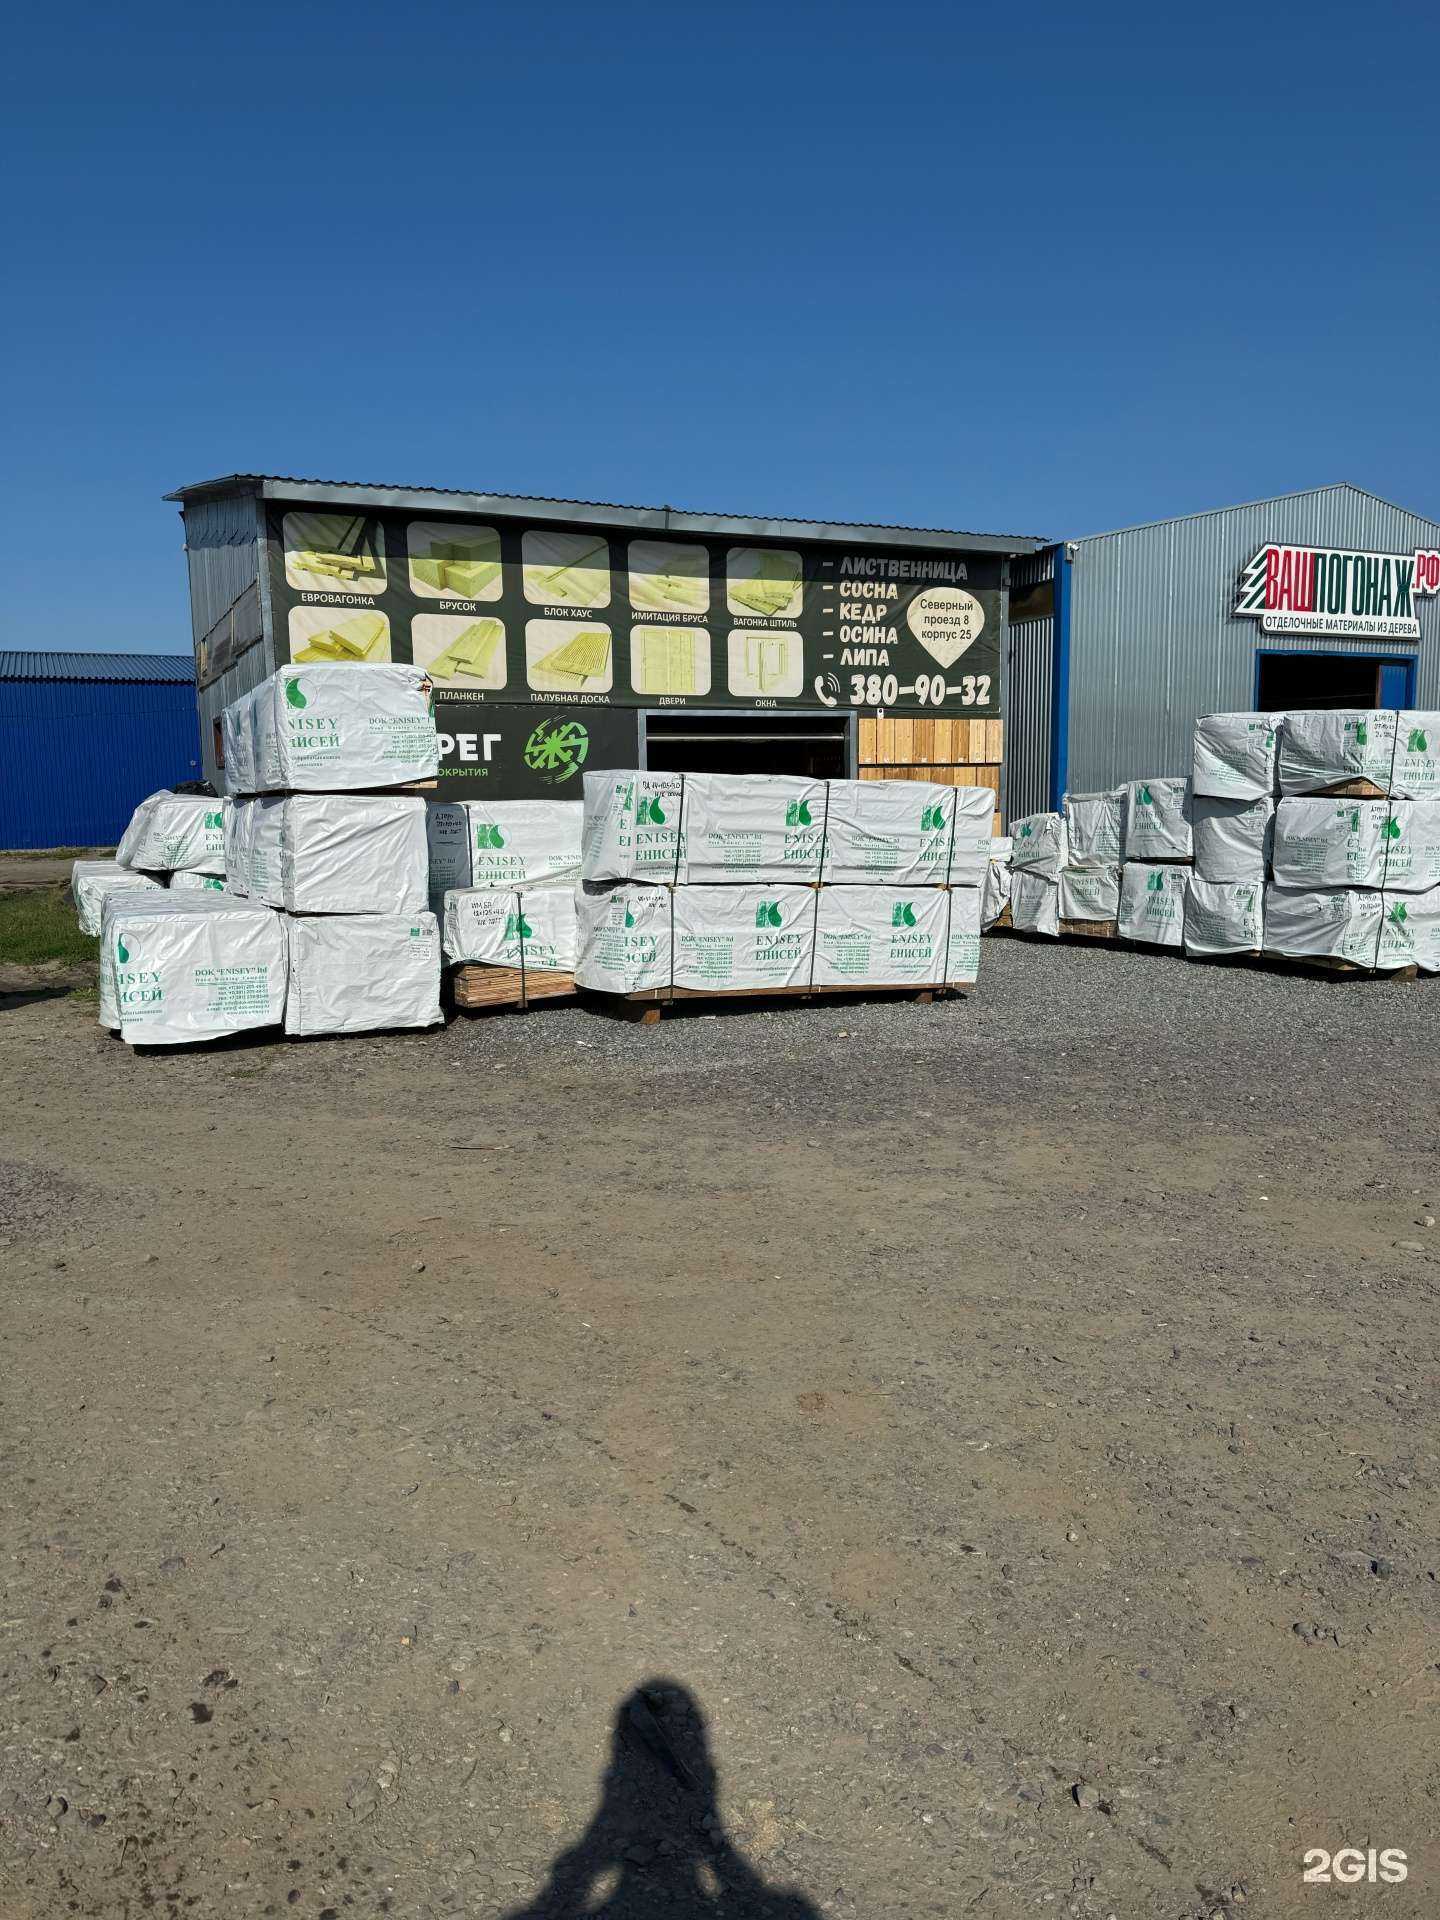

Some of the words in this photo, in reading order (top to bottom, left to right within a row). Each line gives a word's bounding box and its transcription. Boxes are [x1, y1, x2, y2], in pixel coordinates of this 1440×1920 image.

[839, 556, 969, 583] ЛИСТВЕННИЦА
[839, 580, 899, 600] СОСНА
[301, 592, 376, 606] ЕВРОВАГОНКА
[920, 598, 974, 611] Северный
[439, 600, 477, 612] БРУСОК
[544, 607, 569, 617] БЛОК
[570, 608, 593, 618] ХАУС
[631, 611, 681, 623] ИМИТАЦИЯ
[682, 613, 709, 624] БРУСА
[839, 602, 888, 624] КЕДР
[733, 617, 768, 627] ВАГОНКА
[769, 619, 798, 628] ШТИЛЬ
[923, 615, 961, 626] проезд
[963, 615, 970, 625] 8
[1265, 616, 1324, 631] ОТДЕЛОЧНЫЕ
[1325, 619, 1376, 633] МАТЕРИАЛЫ
[1377, 621, 1388, 633] ИЗ
[1388, 623, 1417, 635] ДЕРЕВА
[839, 625, 899, 645] ОСИНА
[921, 630, 958, 642] корпус
[959, 629, 972, 640] 25
[840, 648, 890, 667] ЛИПА
[849, 673, 991, 706] 380-90-32
[439, 691, 485, 702] ПЛАНКЕН
[530, 693, 579, 703] ПАЛУБНАЯ
[580, 694, 611, 704] ДОСКА
[658, 697, 686, 706] ДВЕРИ
[755, 699, 777, 708] ОКНА
[478, 856, 526, 866] ENISEY
[756, 934, 802, 946] ENISEY
[890, 947, 933, 959] ЕНИСЕЙ
[257, 966, 268, 974] ltd
